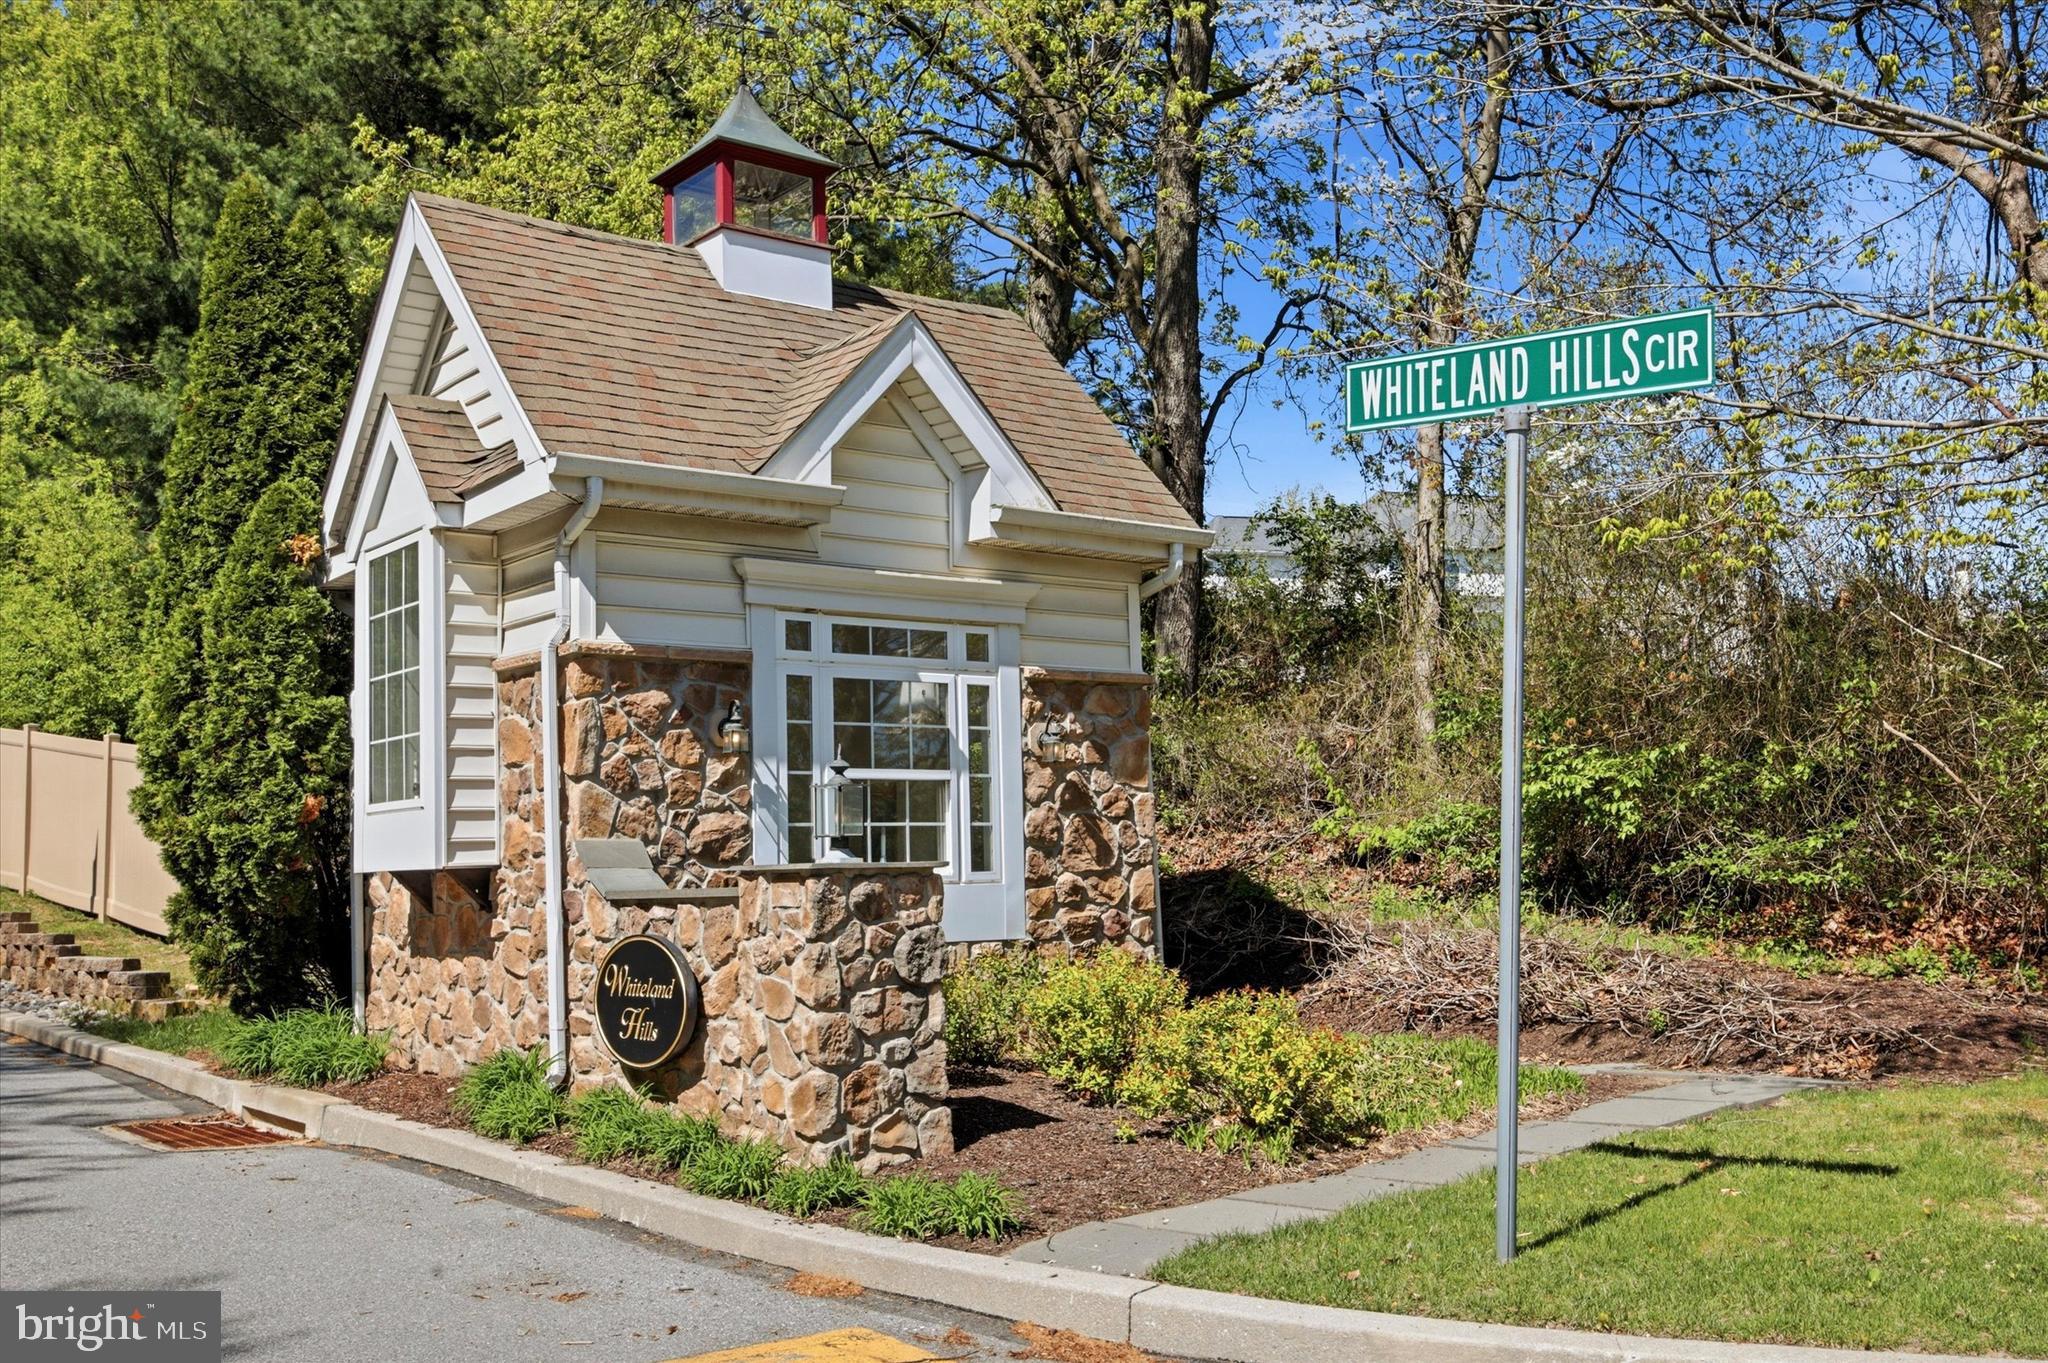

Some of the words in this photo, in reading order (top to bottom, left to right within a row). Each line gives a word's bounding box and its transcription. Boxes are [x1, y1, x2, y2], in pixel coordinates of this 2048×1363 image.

[1360, 346, 1529, 420] WHITELAND
[1549, 328, 1640, 395] HILLS
[1645, 329, 1699, 373] CIR
[604, 963, 675, 999] Whiteland
[619, 1007, 659, 1041] Hills
